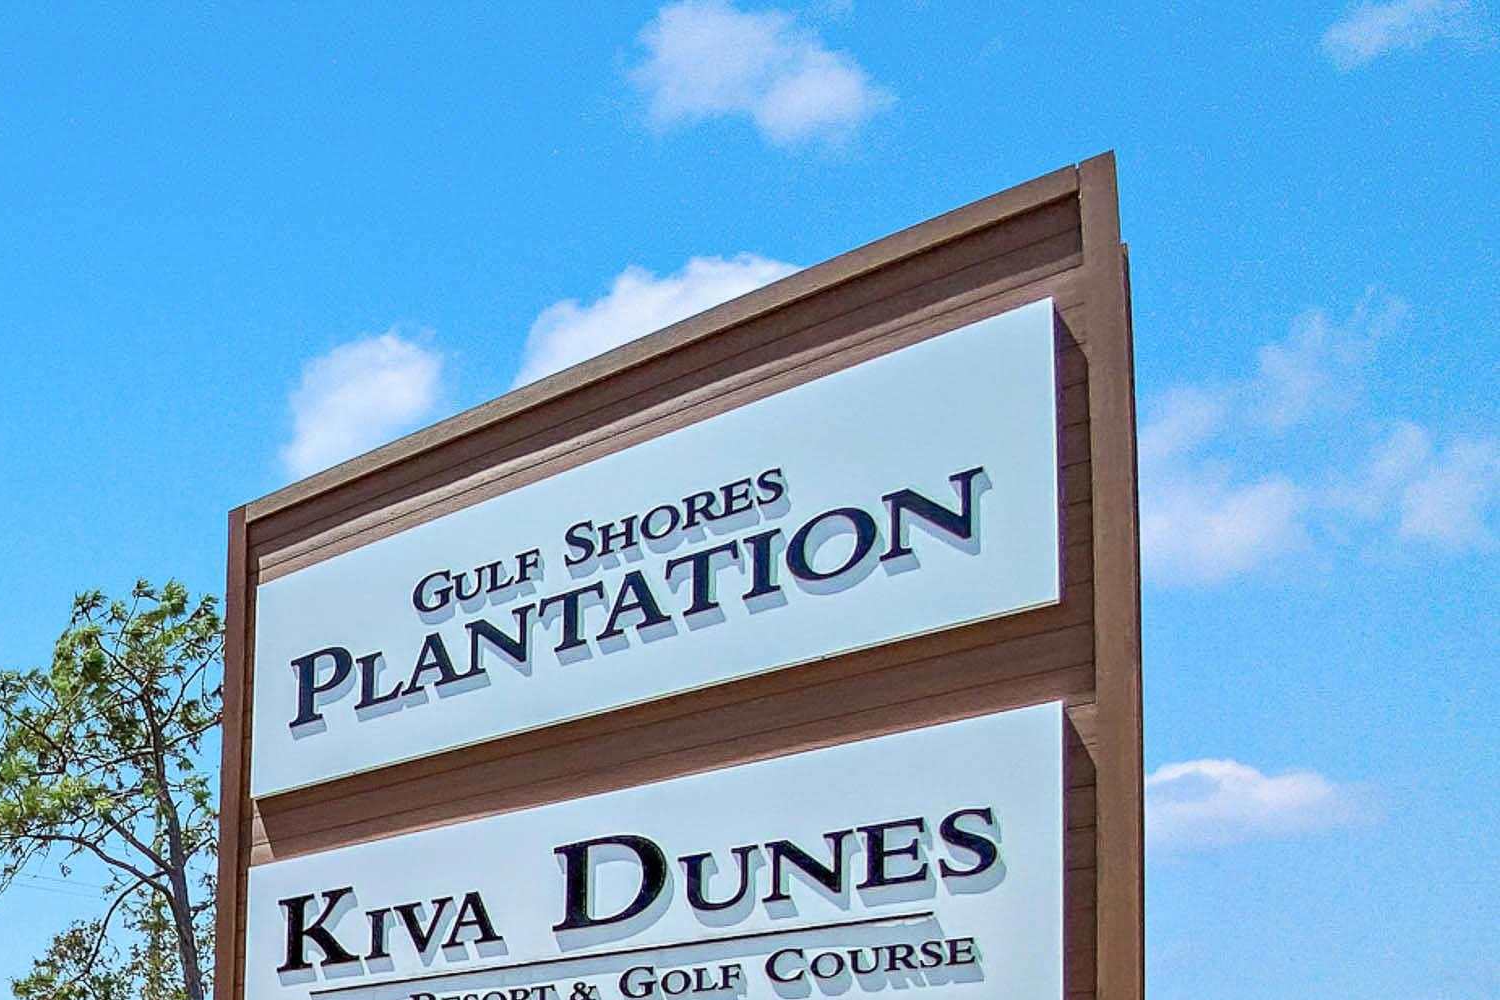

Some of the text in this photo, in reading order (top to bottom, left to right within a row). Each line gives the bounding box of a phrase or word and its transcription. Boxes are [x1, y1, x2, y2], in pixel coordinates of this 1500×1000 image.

[288, 466, 985, 729] PLANTATION
[412, 467, 785, 613] GULF SHORES
[276, 807, 998, 974] KIVA DUNES
[618, 963, 742, 999] GOLF
[764, 937, 976, 984] COURSE
